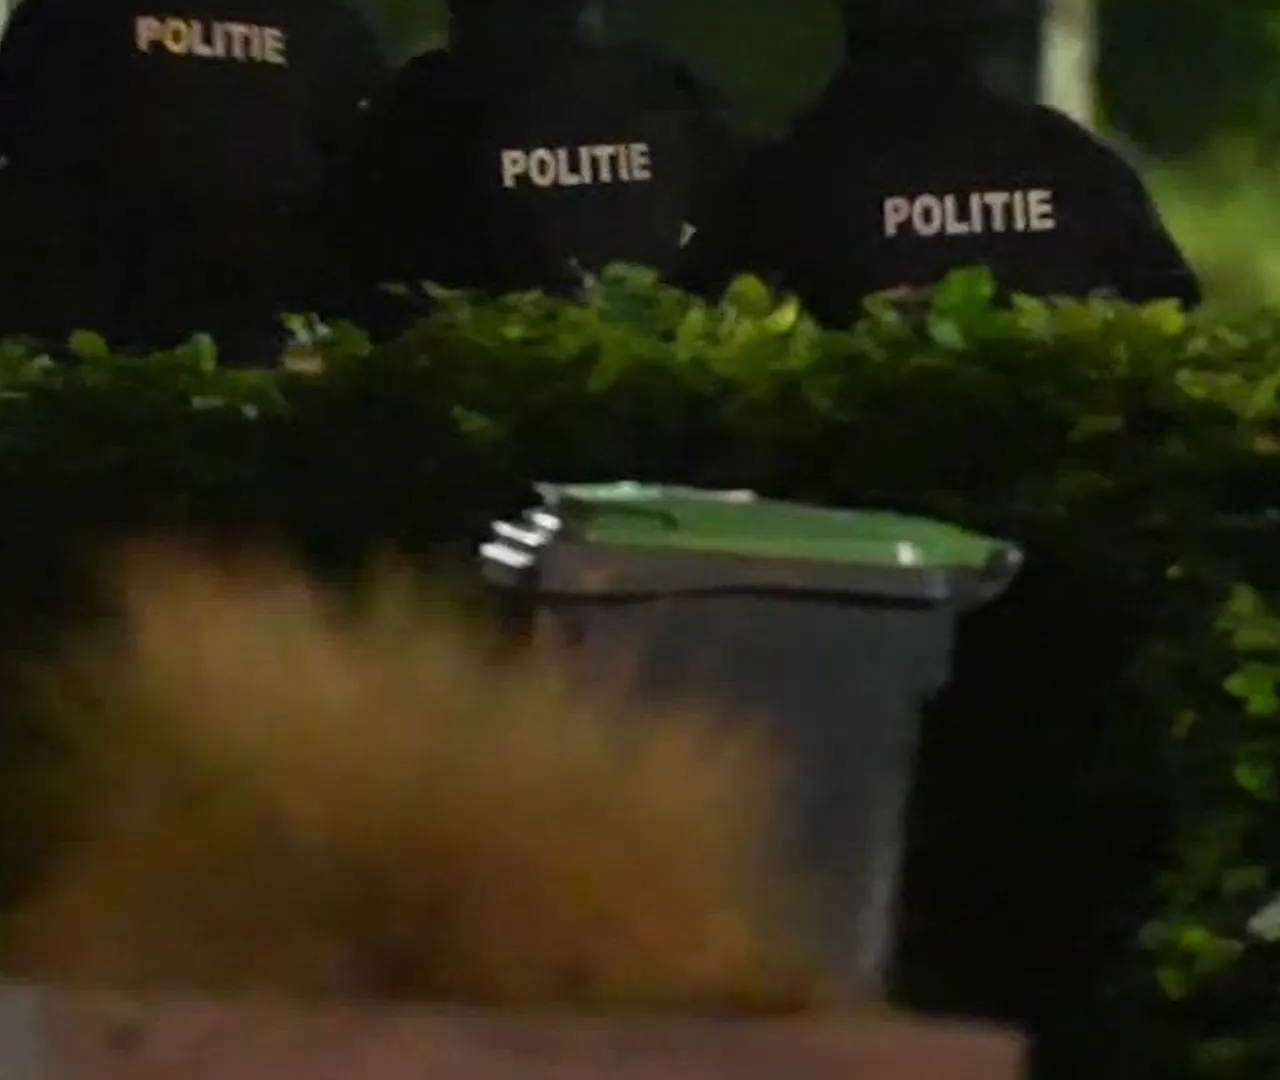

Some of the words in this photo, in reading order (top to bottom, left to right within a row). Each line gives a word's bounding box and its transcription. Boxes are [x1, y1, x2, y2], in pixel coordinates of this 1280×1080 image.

[133, 14, 288, 66] POLITIE
[499, 141, 653, 190] POLITIE
[882, 188, 1057, 238] POLITIE
